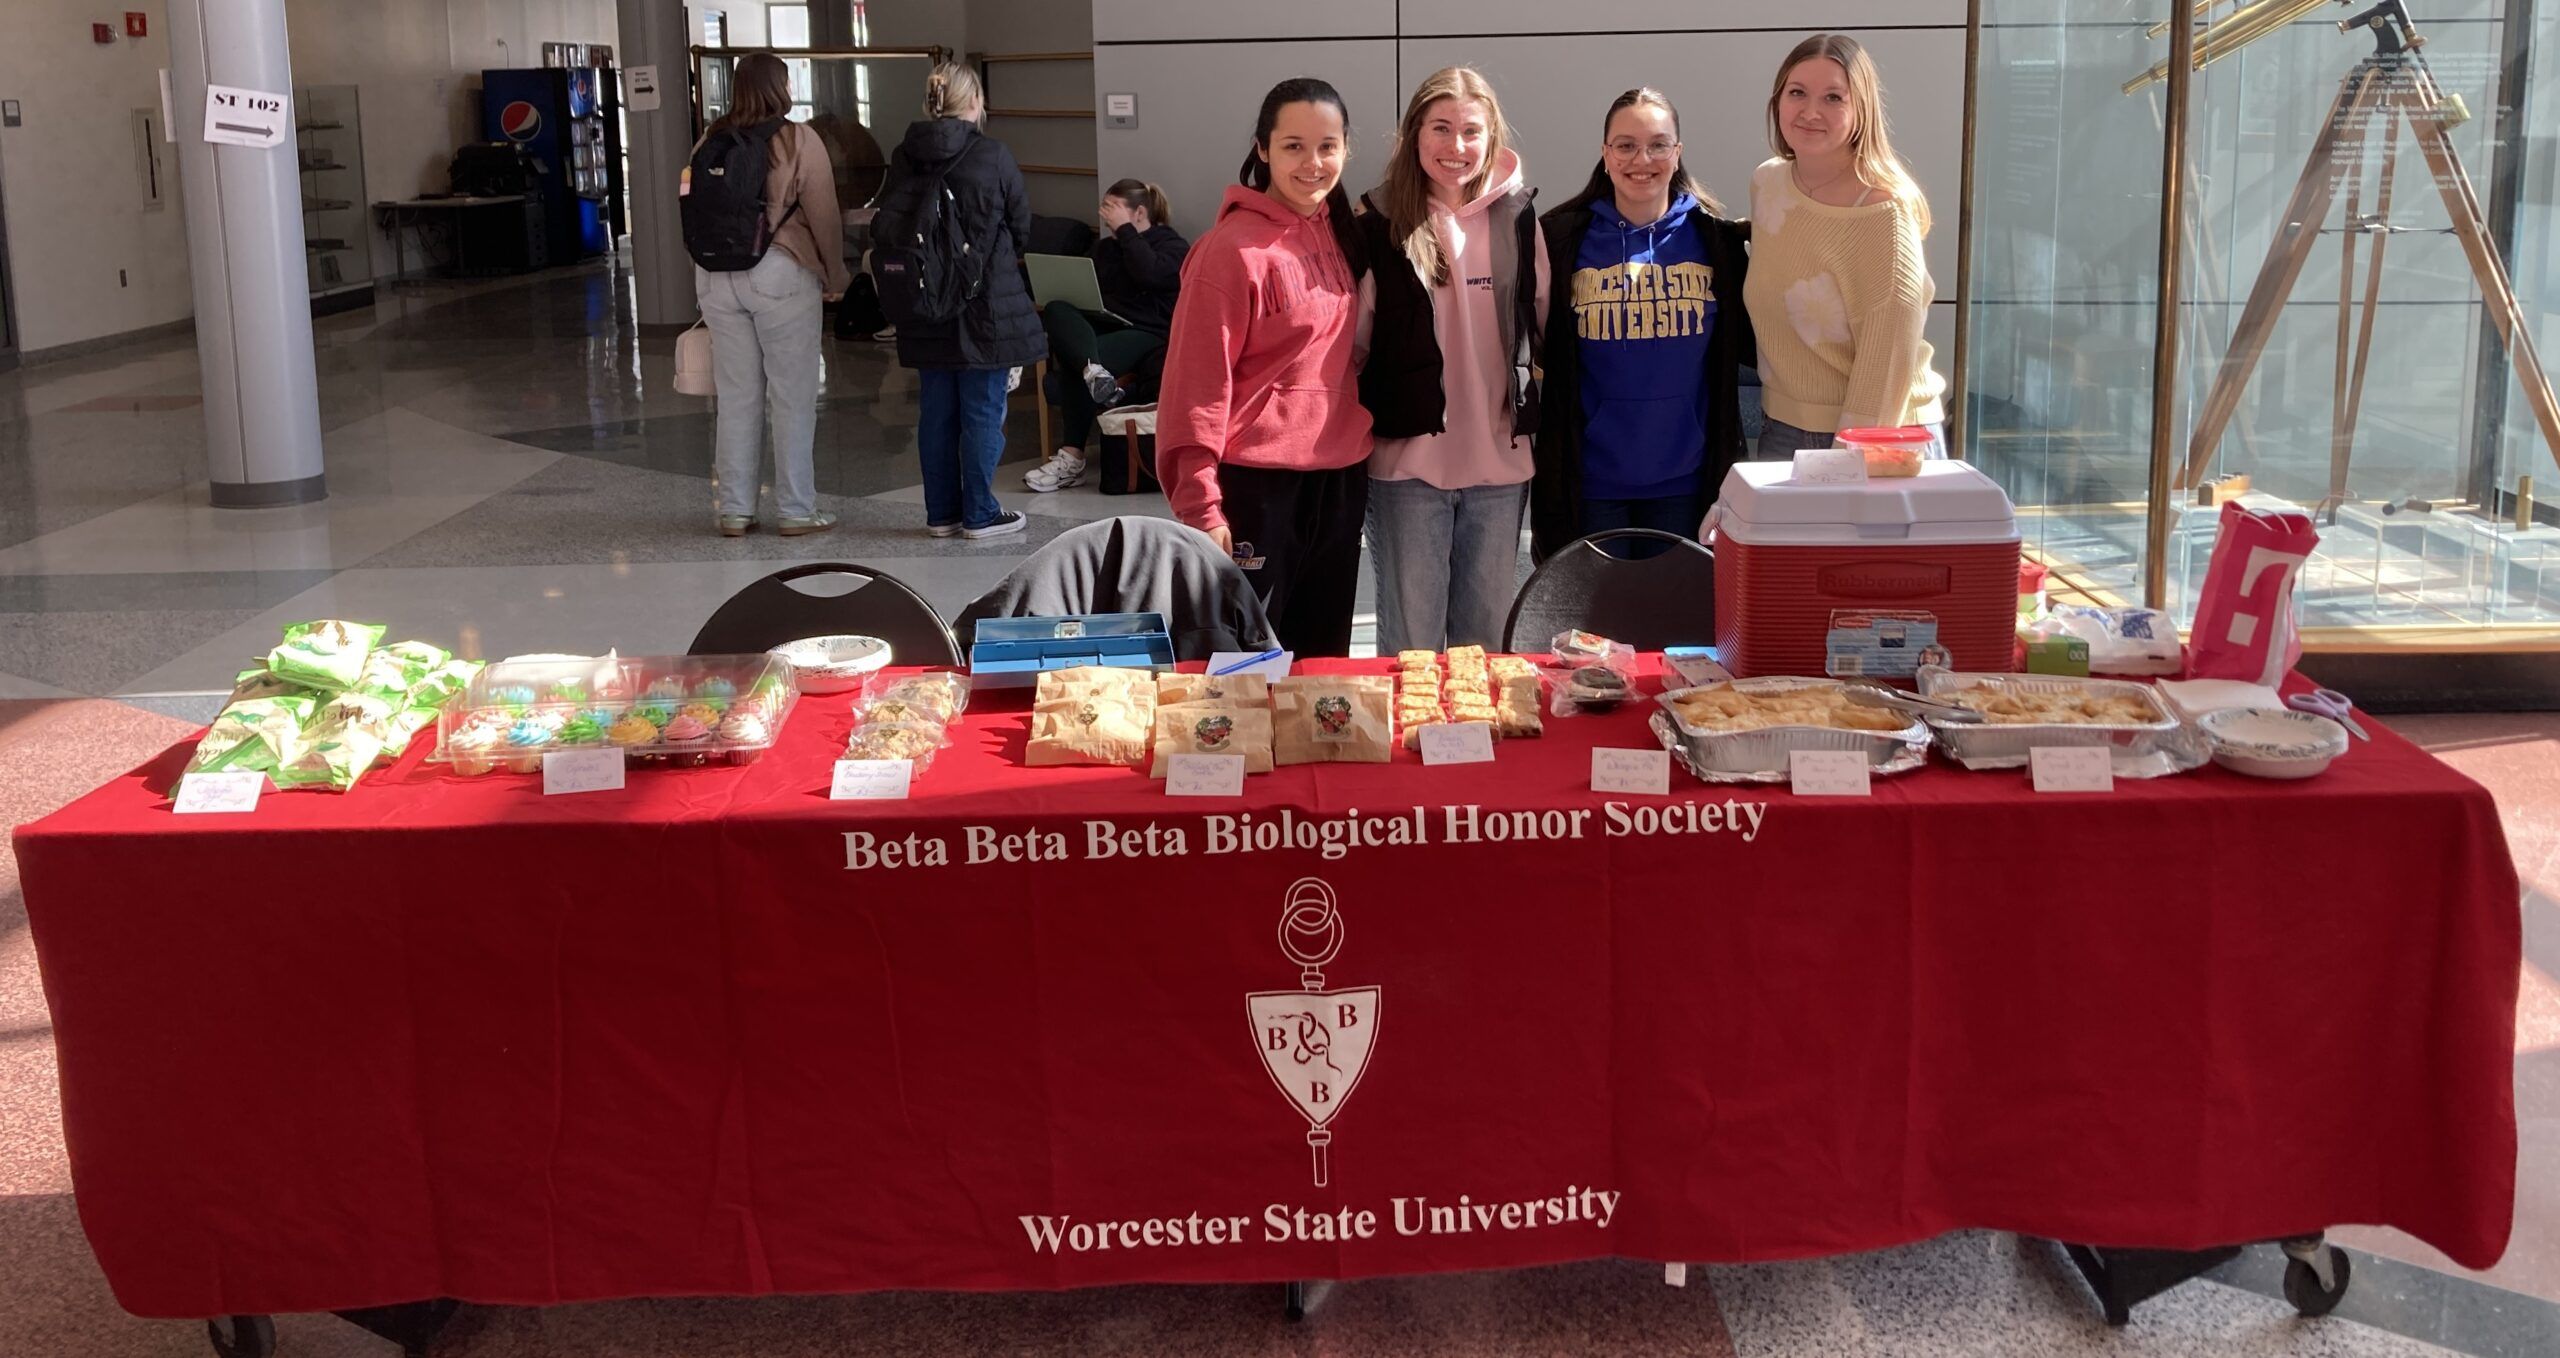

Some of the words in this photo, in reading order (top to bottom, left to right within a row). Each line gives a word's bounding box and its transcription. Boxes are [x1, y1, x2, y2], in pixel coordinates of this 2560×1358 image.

[214, 92, 239, 107] ST
[248, 98, 279, 112] 102
[1666, 262, 1717, 301] STATE
[1574, 300, 1704, 340] UNIVERSITY
[1822, 571, 1945, 590] Rubbermaid
[842, 831, 949, 870] Beta
[963, 826, 1069, 864] Beta
[1083, 820, 1189, 859] Beta
[1203, 806, 1428, 860] Biological
[1441, 804, 1592, 843] Honor
[1604, 798, 1767, 842] Society
[1338, 1004, 1358, 1029] B
[1268, 1027, 1288, 1050] B
[1311, 1081, 1330, 1103] B
[1019, 1210, 1249, 1254] Worcester
[1265, 1204, 1376, 1242] State
[1390, 1186, 1620, 1235] University
